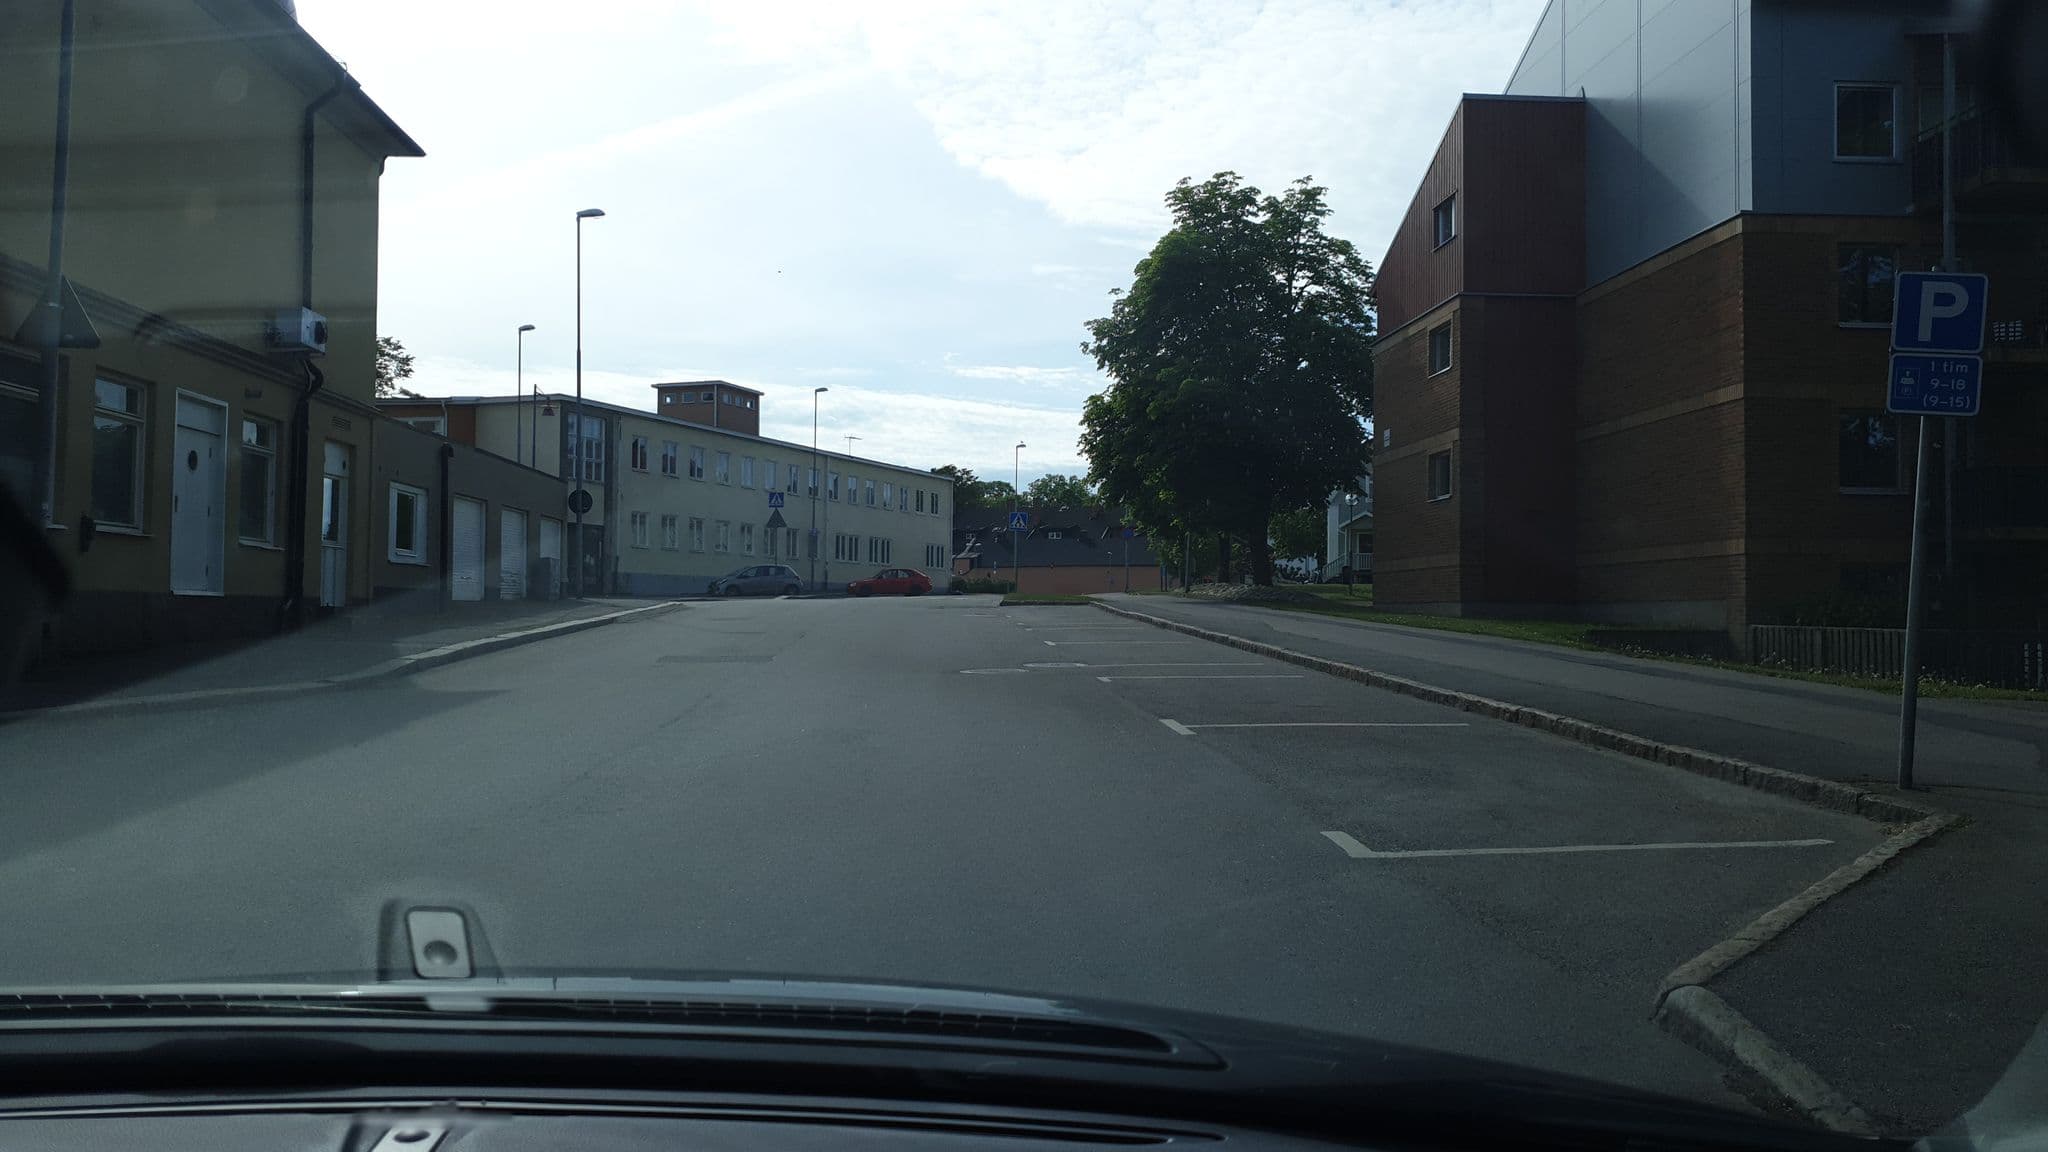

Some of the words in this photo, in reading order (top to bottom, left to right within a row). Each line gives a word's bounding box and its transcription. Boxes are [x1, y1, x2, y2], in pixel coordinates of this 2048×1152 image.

[1918, 281, 1969, 341] P
[1930, 361, 1935, 372] 1
[1943, 361, 1969, 373] tim
[1930, 378, 1966, 391] 9-18
[1923, 394, 1970, 408] (9-15)
